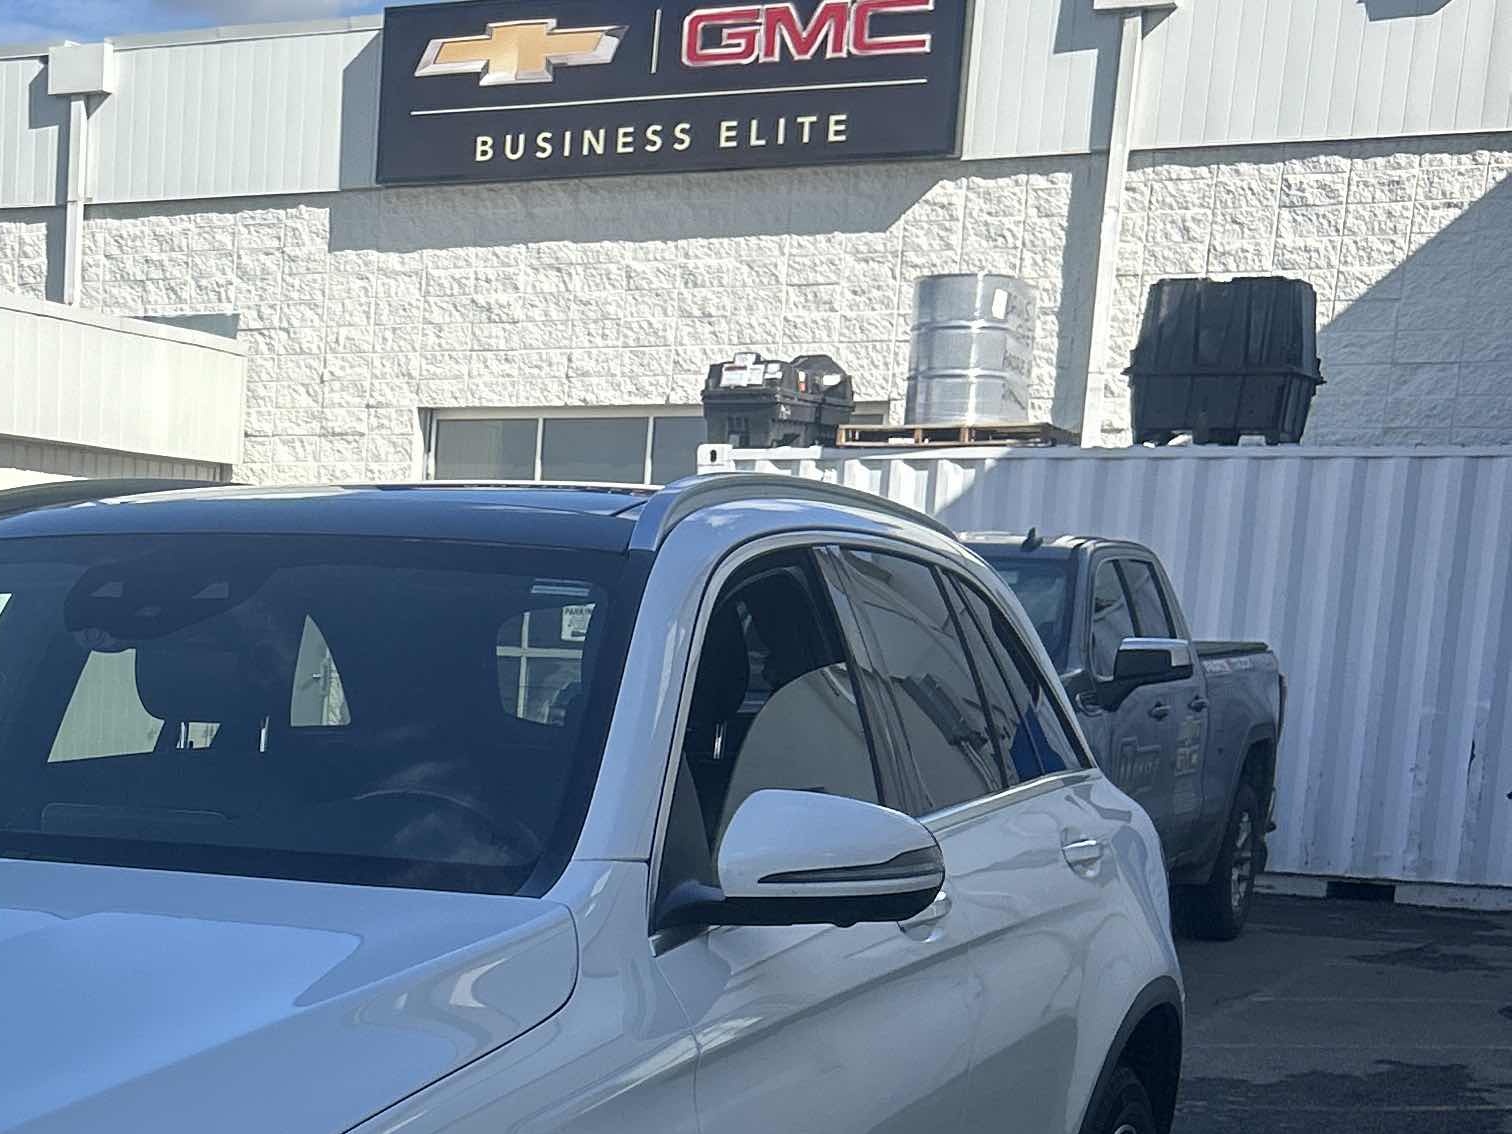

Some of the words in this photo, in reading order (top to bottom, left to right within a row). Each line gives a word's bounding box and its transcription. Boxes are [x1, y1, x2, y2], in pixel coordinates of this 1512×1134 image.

[681, 0, 936, 67] GMC
[474, 122, 692, 162] BUSINESS
[719, 113, 849, 149] ELITE
